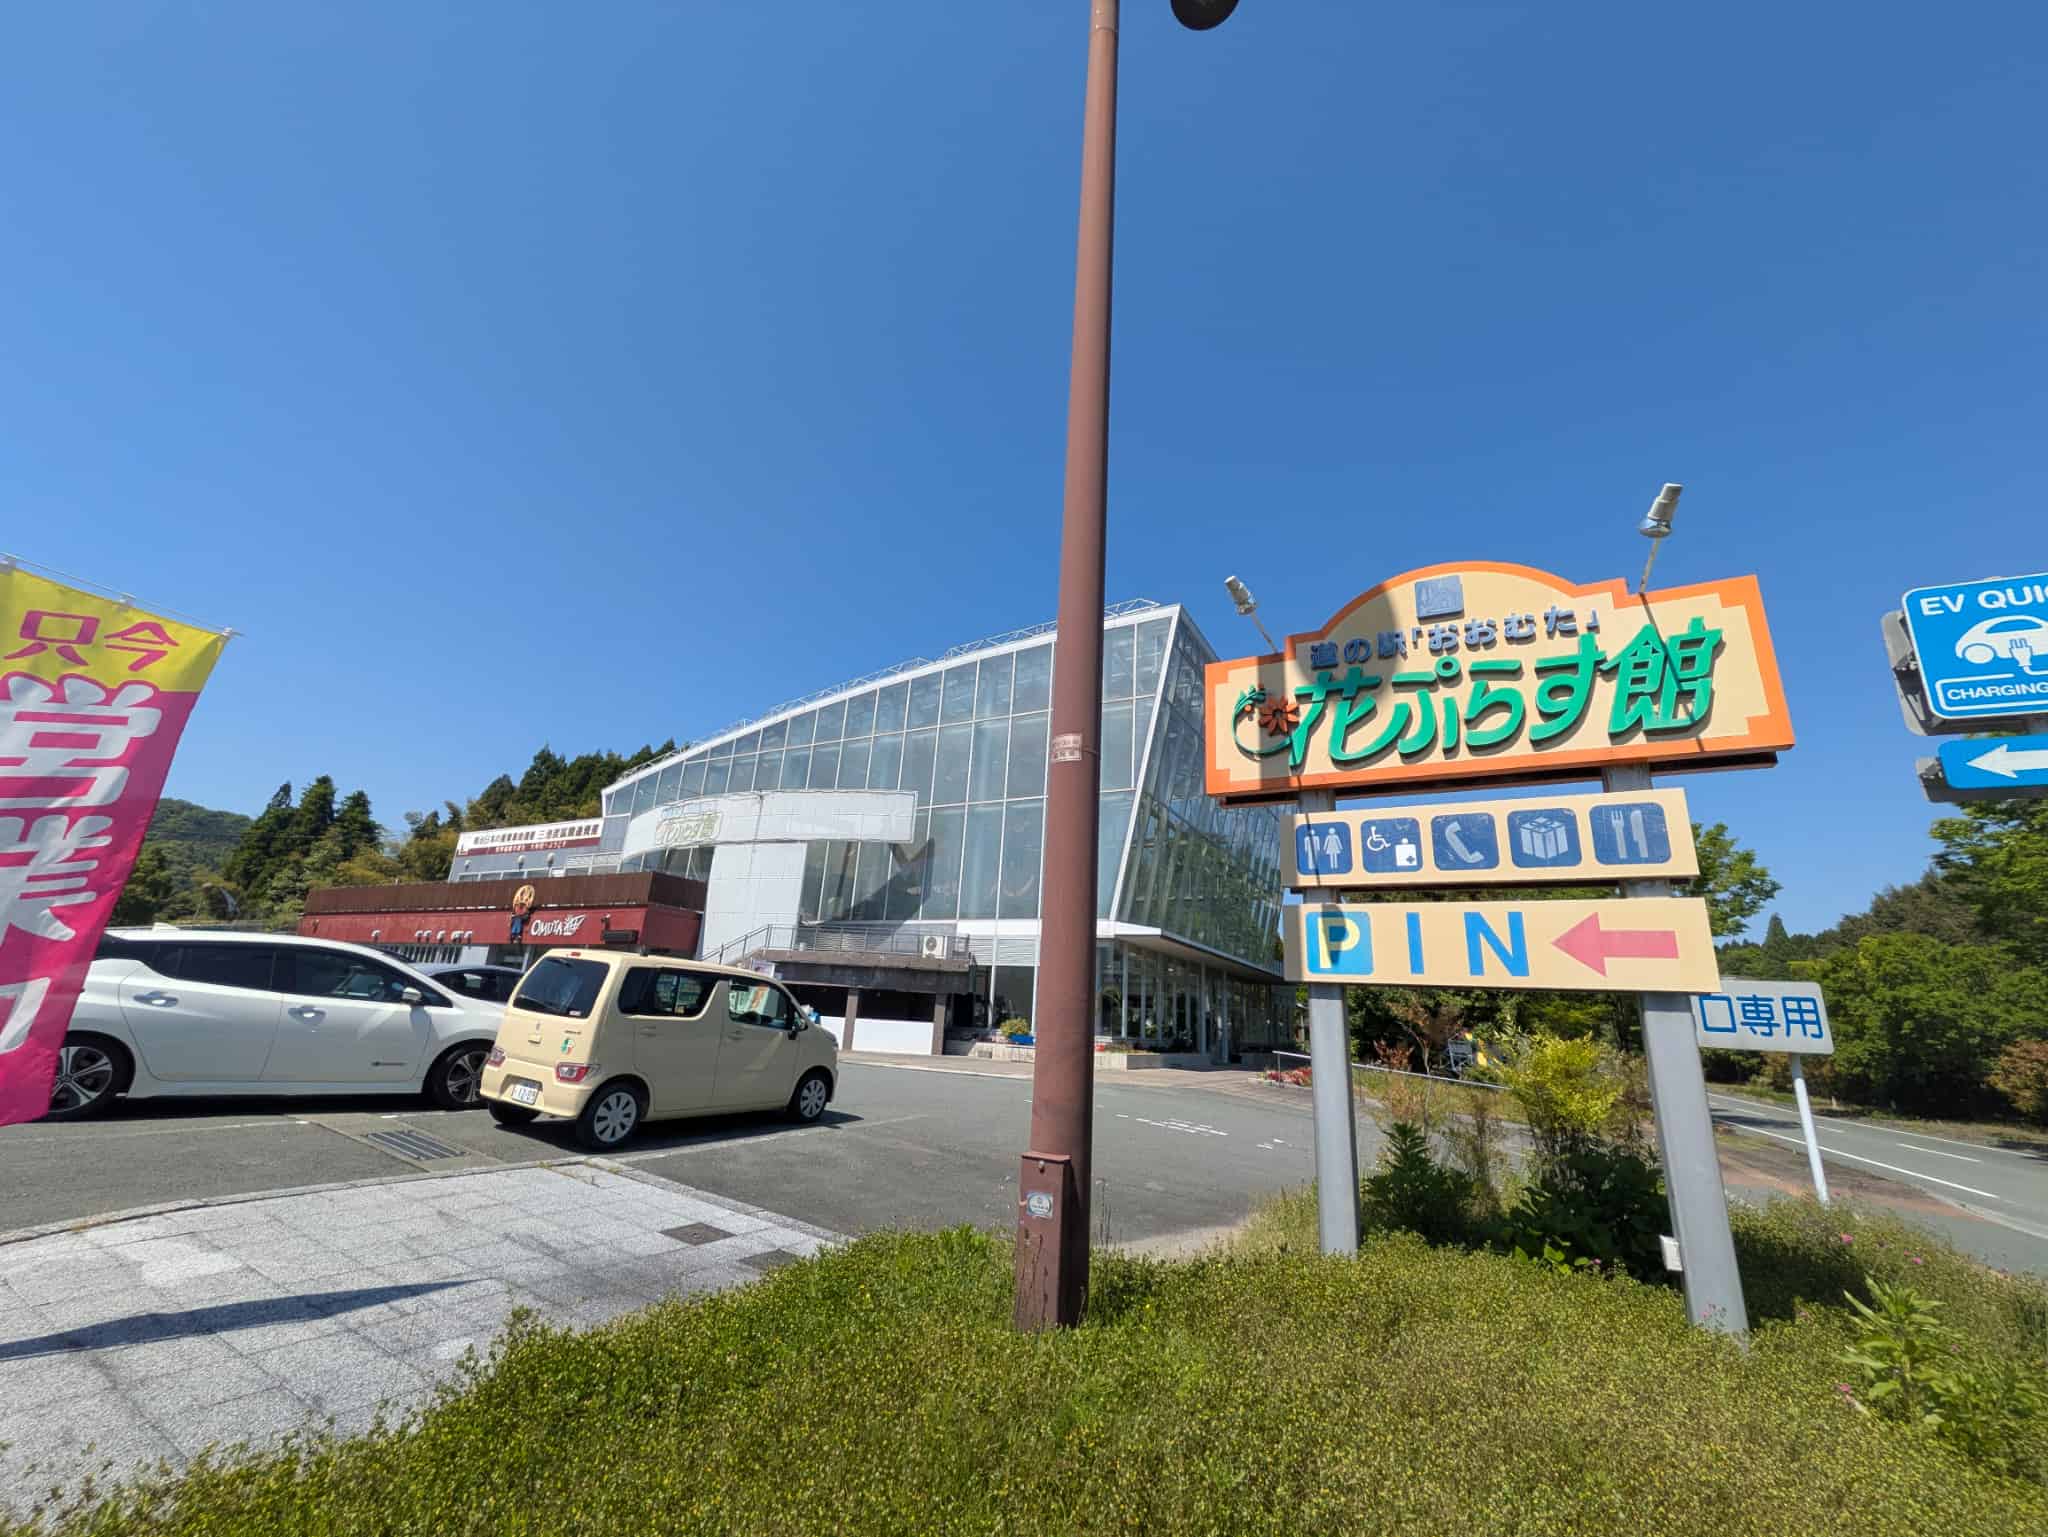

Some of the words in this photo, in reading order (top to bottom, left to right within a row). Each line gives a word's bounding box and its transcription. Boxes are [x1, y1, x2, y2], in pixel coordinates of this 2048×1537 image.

[1919, 593, 1965, 617] EV
[1977, 584, 2048, 609] QUI
[4, 609, 180, 672] 只今
[1288, 616, 1724, 768] 花ぷらす館
